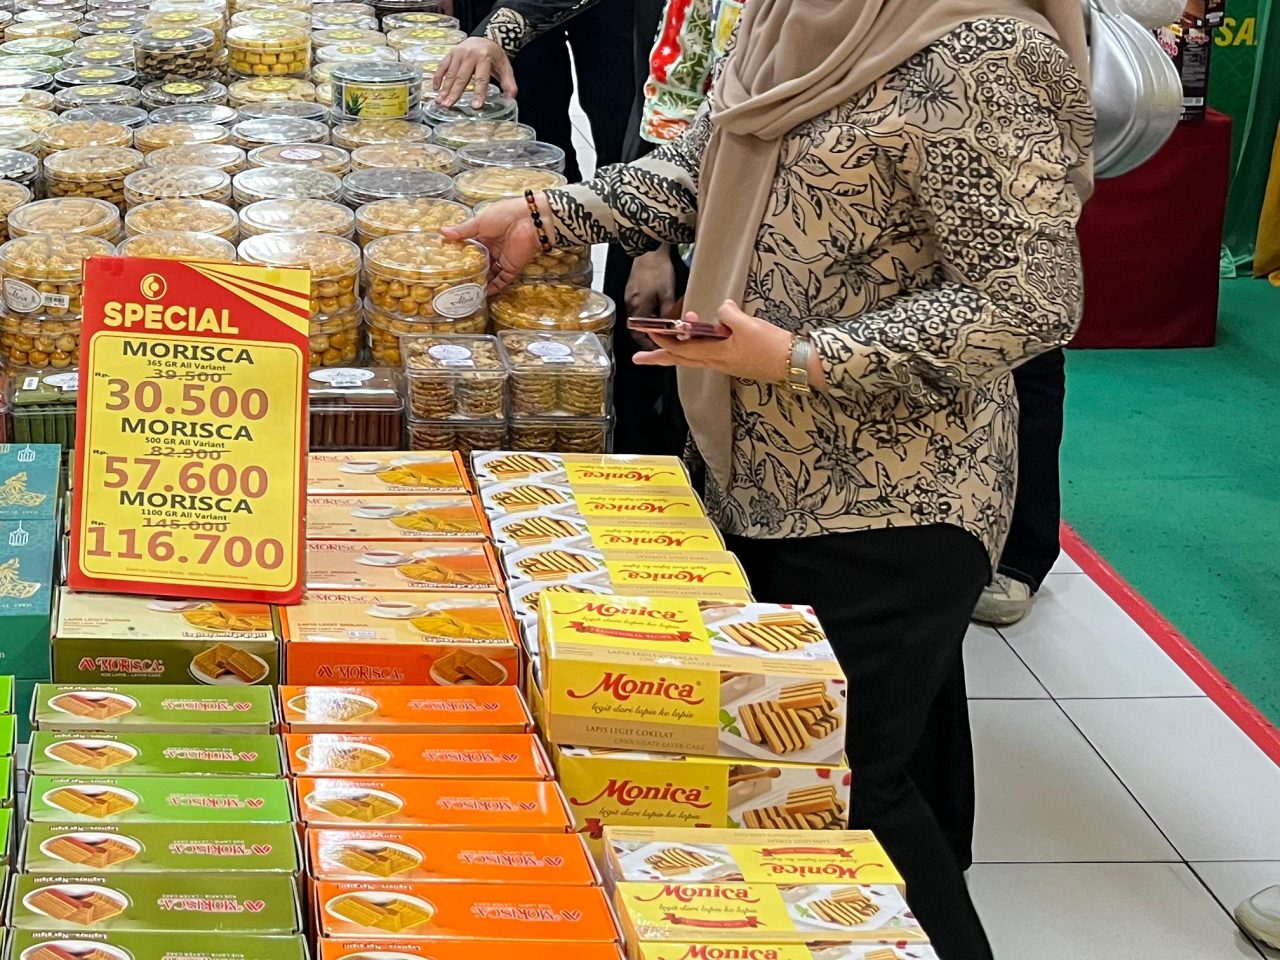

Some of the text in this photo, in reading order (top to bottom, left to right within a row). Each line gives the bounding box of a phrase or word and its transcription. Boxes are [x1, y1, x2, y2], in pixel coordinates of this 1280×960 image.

[104, 302, 239, 334] SPECIAL
[123, 340, 254, 364] MORISCA
[194, 363, 226, 371] Variant
[105, 379, 269, 420] 30.500
[121, 417, 254, 441] MORISCA
[145, 436, 226, 449] 500 GR All Variant
[103, 456, 268, 499] 57.600
[575, 470, 676, 481] Monica
[119, 491, 254, 514] MORISCA
[586, 502, 690, 513] Monica
[141, 509, 161, 517] 1100
[163, 510, 177, 518] GR
[193, 512, 227, 521] Variant
[87, 526, 284, 570] 116.700
[600, 535, 708, 548] Monica
[618, 569, 731, 583] Monica
[552, 602, 688, 623] Monica
[96, 657, 164, 673] MORISCA
[335, 665, 404, 679] MORISCA
[567, 671, 704, 705] Monica
[591, 702, 613, 713] legit
[615, 703, 633, 714] dari
[634, 706, 657, 718] lapis
[673, 709, 694, 720] lapis
[586, 725, 674, 738] LAPIS LEGIT COKELAT
[570, 779, 712, 809] Monica
[768, 863, 883, 879] Monica
[634, 884, 760, 904] Monica
[654, 945, 781, 960] Monica
